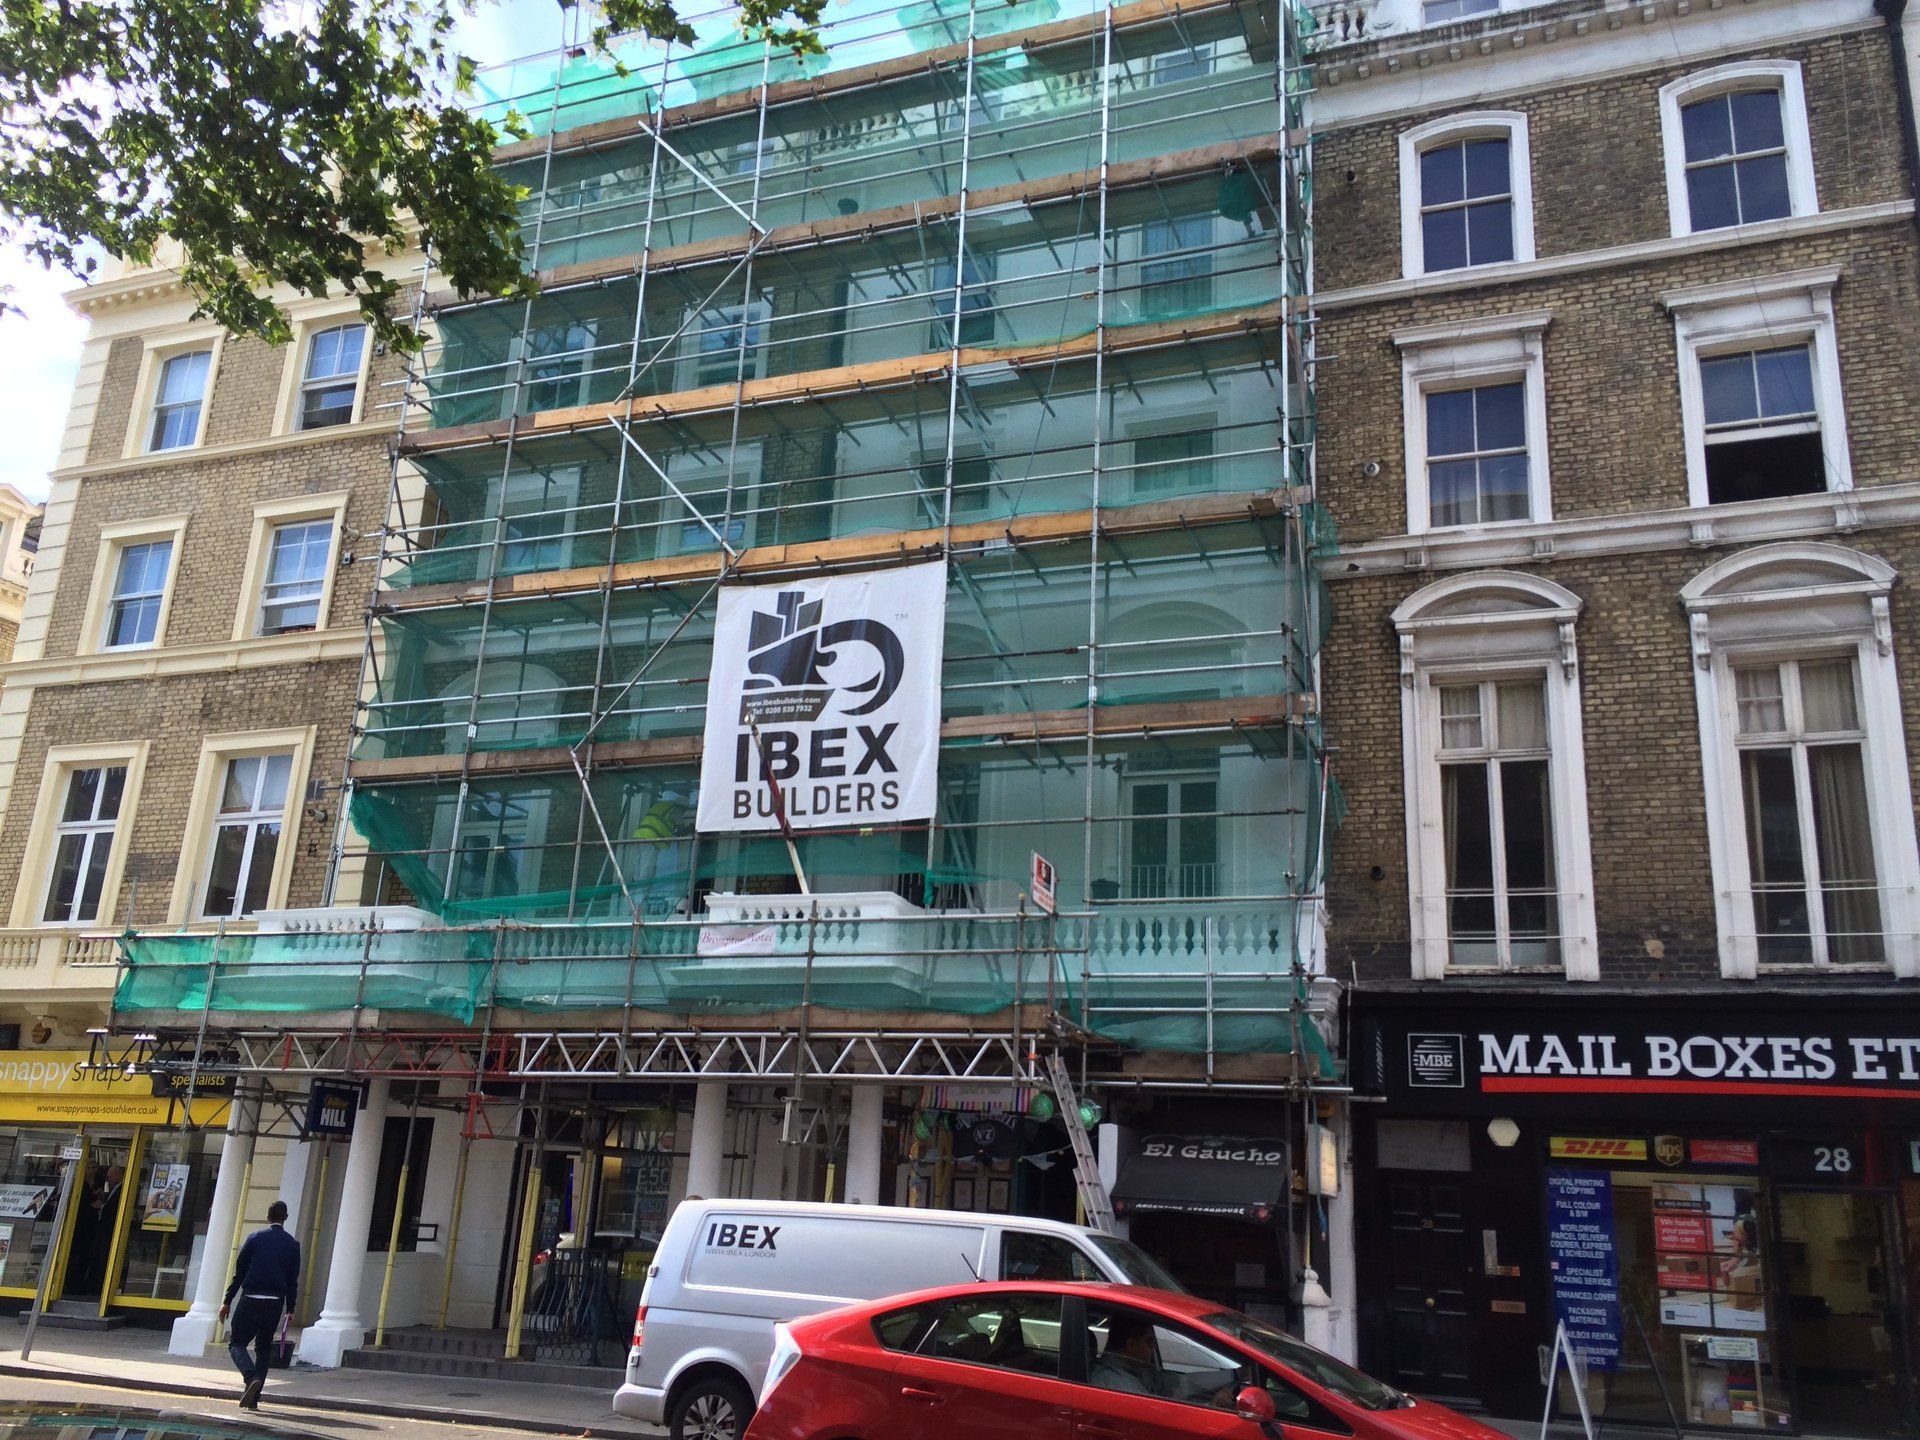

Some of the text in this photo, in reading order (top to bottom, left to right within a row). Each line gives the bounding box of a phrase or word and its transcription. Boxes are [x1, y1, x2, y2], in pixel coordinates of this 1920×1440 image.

[735, 722, 899, 782] IBEX
[733, 781, 899, 819] BUILDERS
[1418, 1054, 1453, 1067] MBE
[1478, 1034, 1632, 1076] MAIL
[1644, 1035, 1836, 1080] BOXES
[171, 1074, 226, 1088] speialists
[37, 1104, 158, 1115] www.snappysnaps-southken.co.uk
[320, 1107, 346, 1127] HILL
[1142, 1143, 1281, 1162] El Gaucho
[1563, 1140, 1633, 1157] DHL
[1657, 1142, 1681, 1162] ups
[1814, 1147, 1851, 1172] 28
[1549, 1177, 1605, 1187] DIGITAL PRINTING
[1566, 1187, 1595, 1195] COPYING
[1187, 1206, 1245, 1215] STEAKHOUSE
[1556, 1200, 1601, 1210] FULL COLOUR
[1560, 1224, 1600, 1233] WORLDWIDE
[706, 1223, 781, 1250] IBEX
[1551, 1231, 1609, 1242] PARCEL DELIVERY
[1582, 1241, 1612, 1251] EXPRESS
[1565, 1249, 1605, 1259] SCHEDULED
[1566, 1267, 1604, 1277] SPECIALIST
[1554, 1275, 1612, 1286] PACKING SERVICE
[1556, 1290, 1617, 1302] ENHANCED COVER
[1568, 1306, 1607, 1316] PACKAGING
[1569, 1315, 1607, 1325] MATERIALS
[1566, 1330, 1590, 1340] AILBOX
